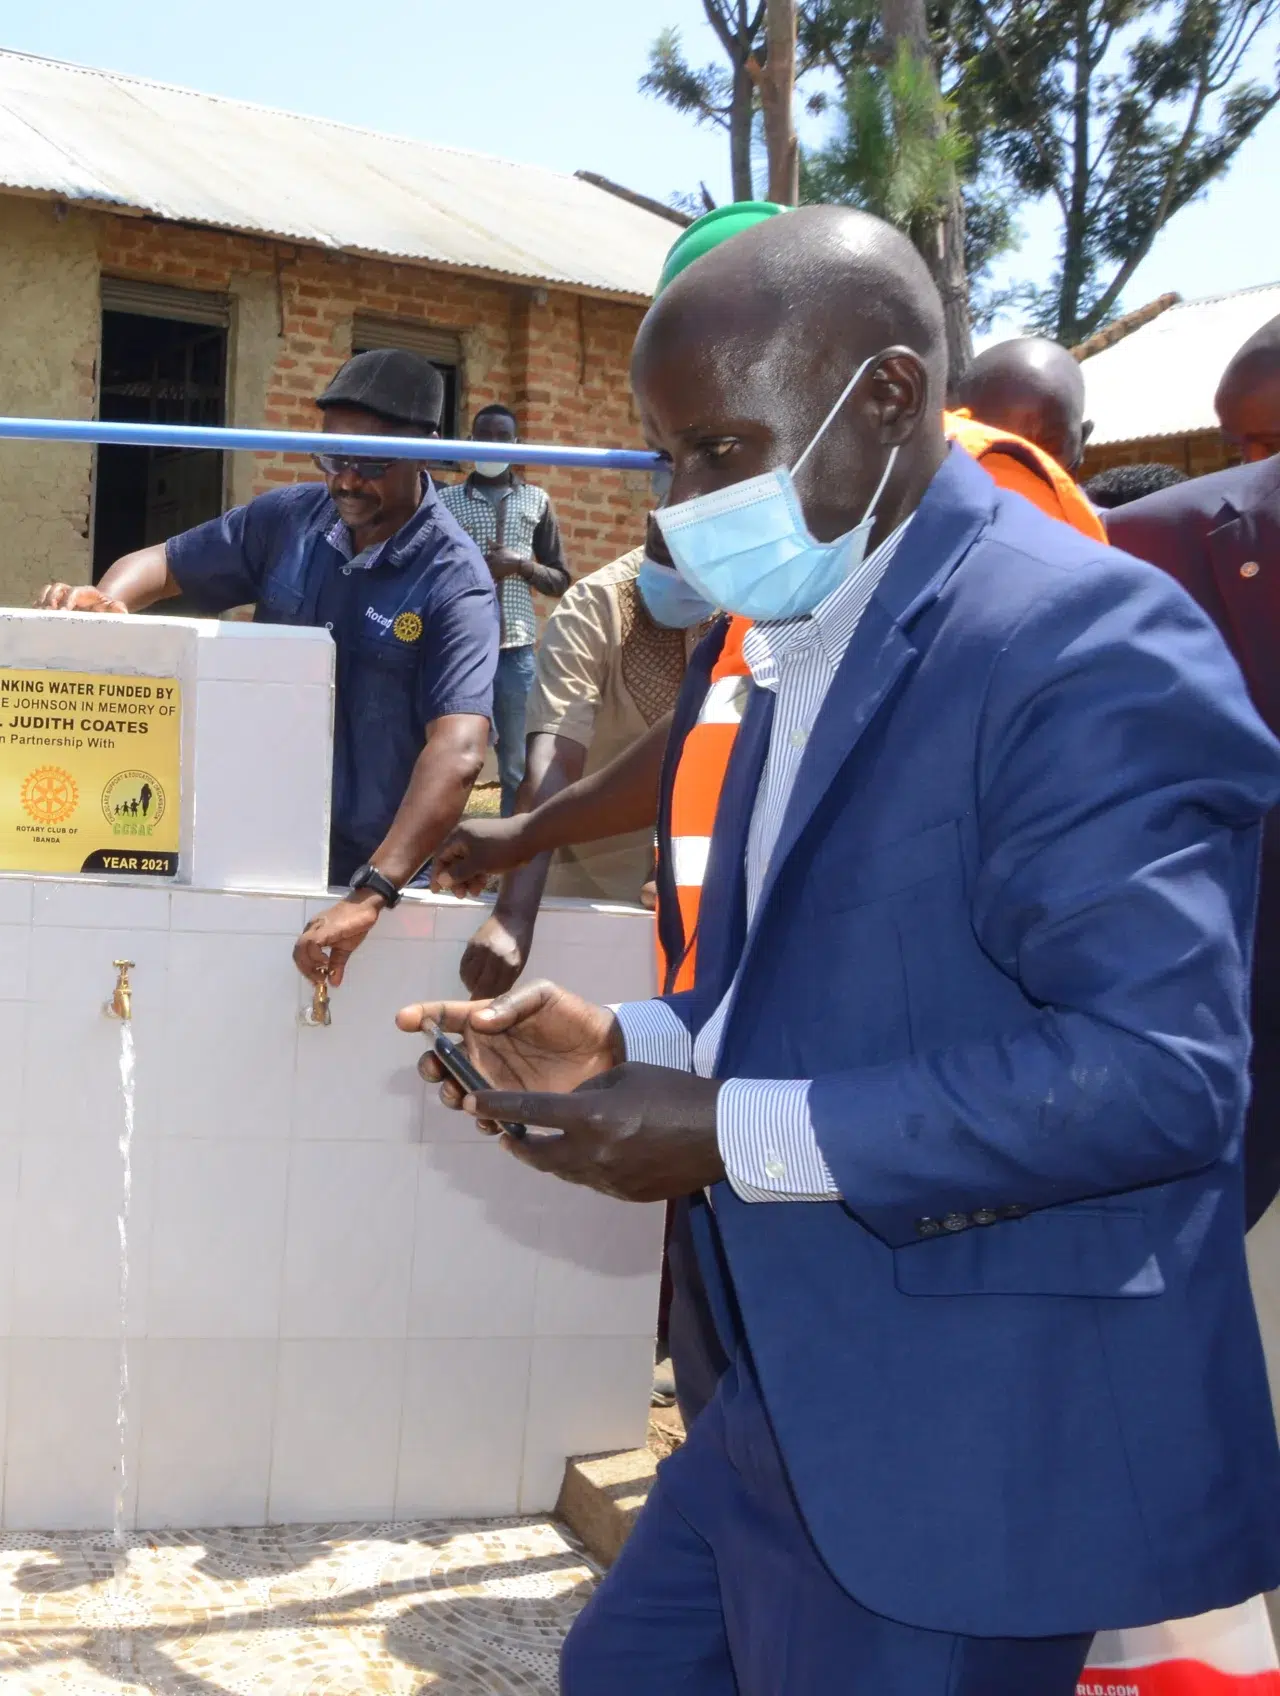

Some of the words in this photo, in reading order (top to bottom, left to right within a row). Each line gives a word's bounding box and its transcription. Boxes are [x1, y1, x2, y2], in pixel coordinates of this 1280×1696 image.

[49, 682, 94, 696] WATER
[99, 684, 152, 699] FUNDED
[156, 687, 174, 700] BY
[13, 698, 77, 711] JOHNSON
[81, 701, 94, 712] IN
[98, 702, 155, 715] MEMORY
[159, 705, 176, 716] OF
[9, 716, 74, 731] JUDITH
[80, 719, 149, 734] COATES
[10, 734, 83, 749] Partnership
[87, 738, 115, 749] With
[16, 825, 45, 833] ROTARY
[102, 856, 138, 870] YEAR
[141, 858, 169, 871] 2021
